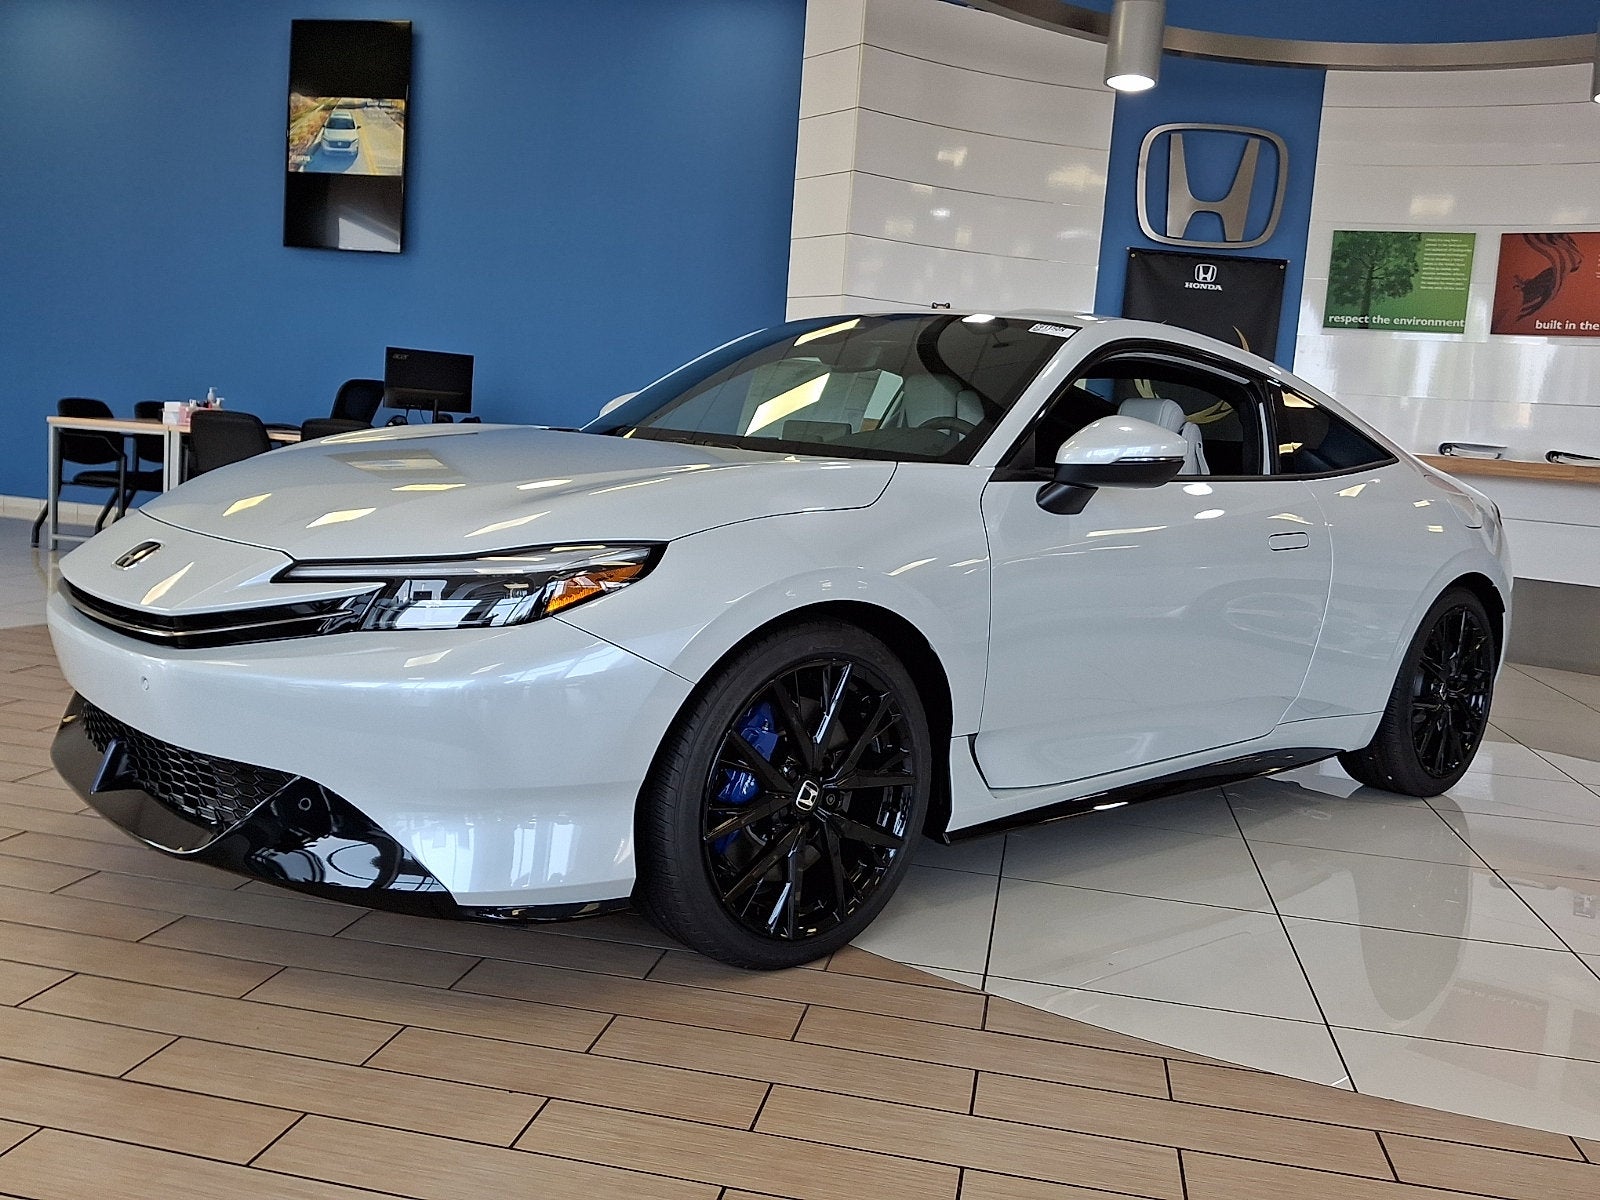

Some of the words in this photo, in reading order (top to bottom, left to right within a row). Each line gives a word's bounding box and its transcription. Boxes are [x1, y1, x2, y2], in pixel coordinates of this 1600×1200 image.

[1184, 281, 1223, 291] HONDA
[1328, 315, 1369, 325] respect
[1372, 315, 1390, 325] the
[1393, 316, 1465, 328] environment
[1535, 320, 1562, 330] built
[1565, 320, 1576, 330] in
[1579, 320, 1600, 331] the
